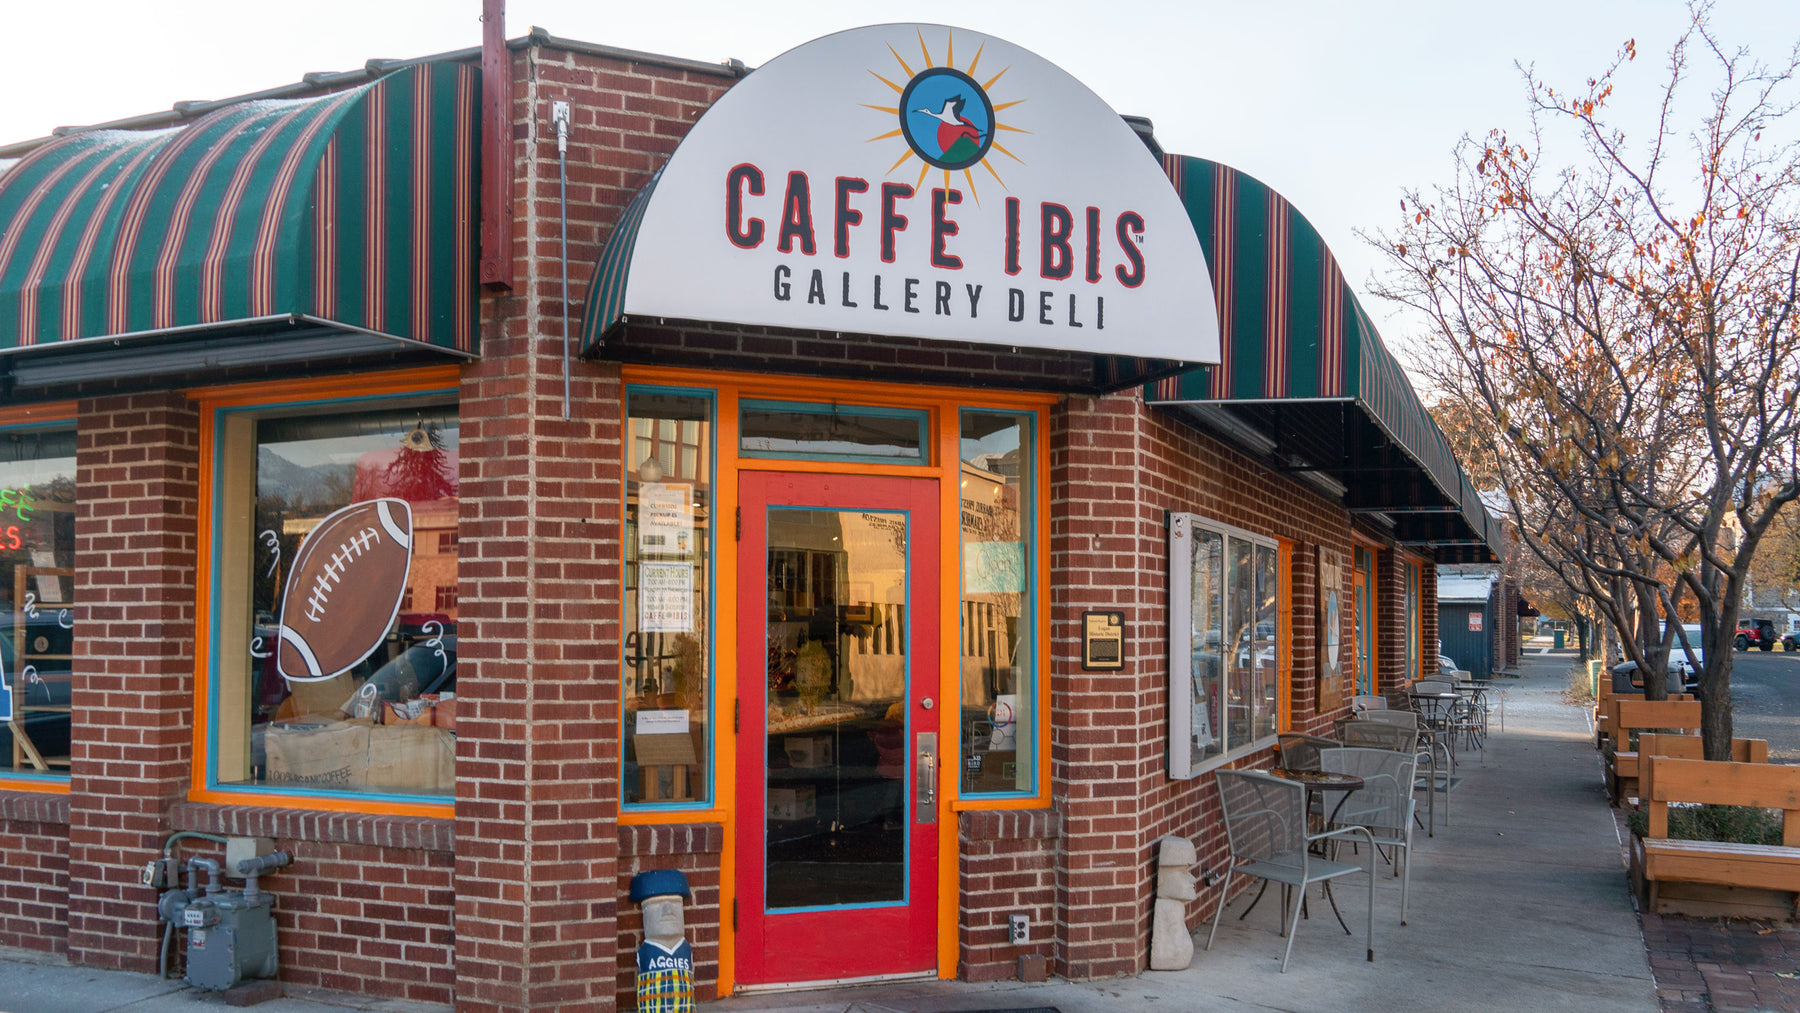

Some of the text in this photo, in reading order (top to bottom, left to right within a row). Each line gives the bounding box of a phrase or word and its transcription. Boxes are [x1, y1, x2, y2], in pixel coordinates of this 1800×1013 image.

[726, 163, 1145, 288] CAFFE IBIS
[774, 265, 1104, 330] GALLERY DELI
[649, 956, 689, 970] AGGIES
